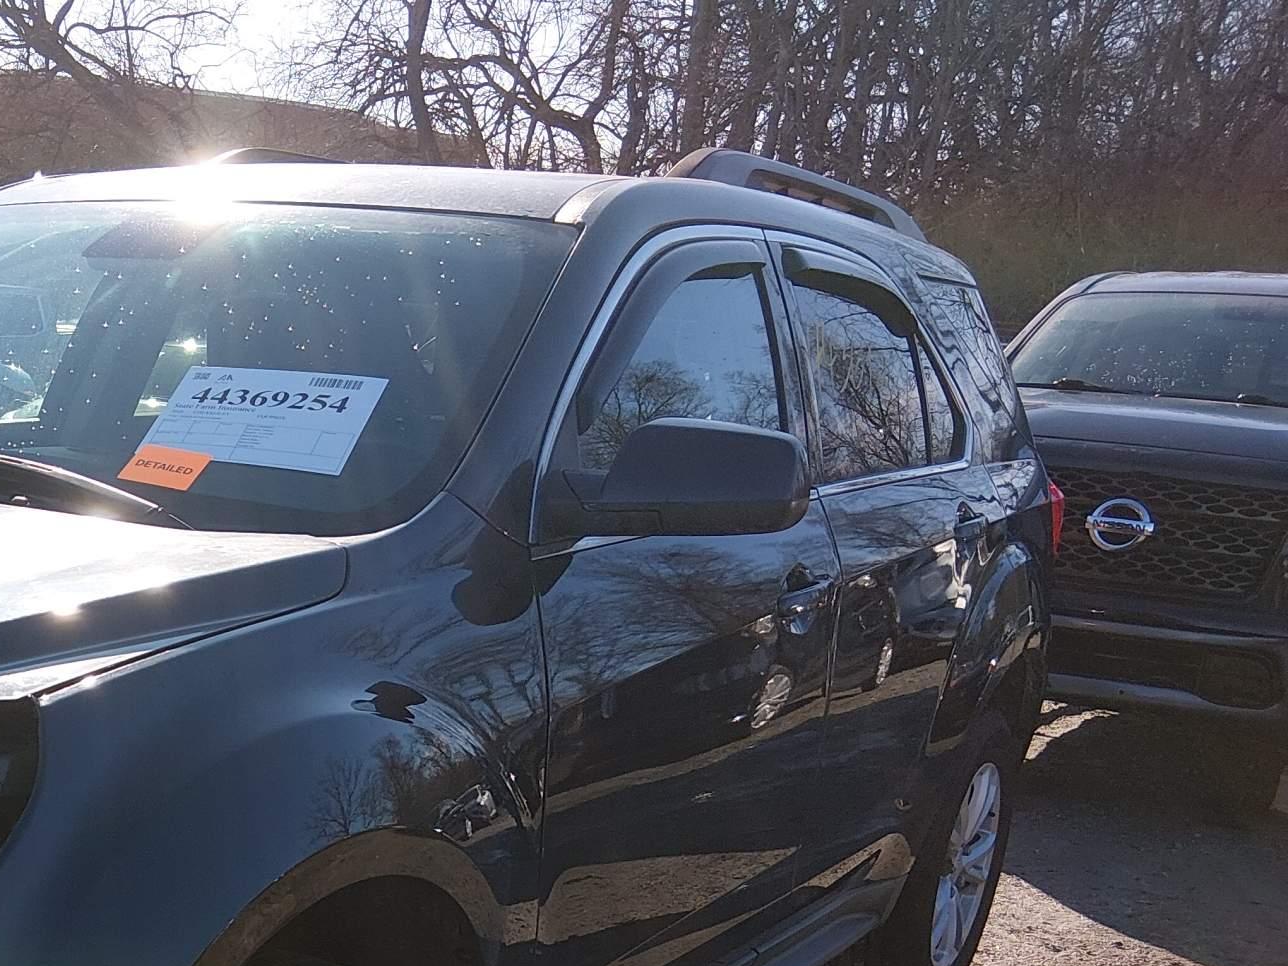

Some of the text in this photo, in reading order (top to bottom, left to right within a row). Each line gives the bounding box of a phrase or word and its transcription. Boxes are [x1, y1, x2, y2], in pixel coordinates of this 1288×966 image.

[191, 387, 350, 413] 44369254
[134, 458, 194, 475] DETAILED
[1093, 519, 1146, 533] NISSAN
